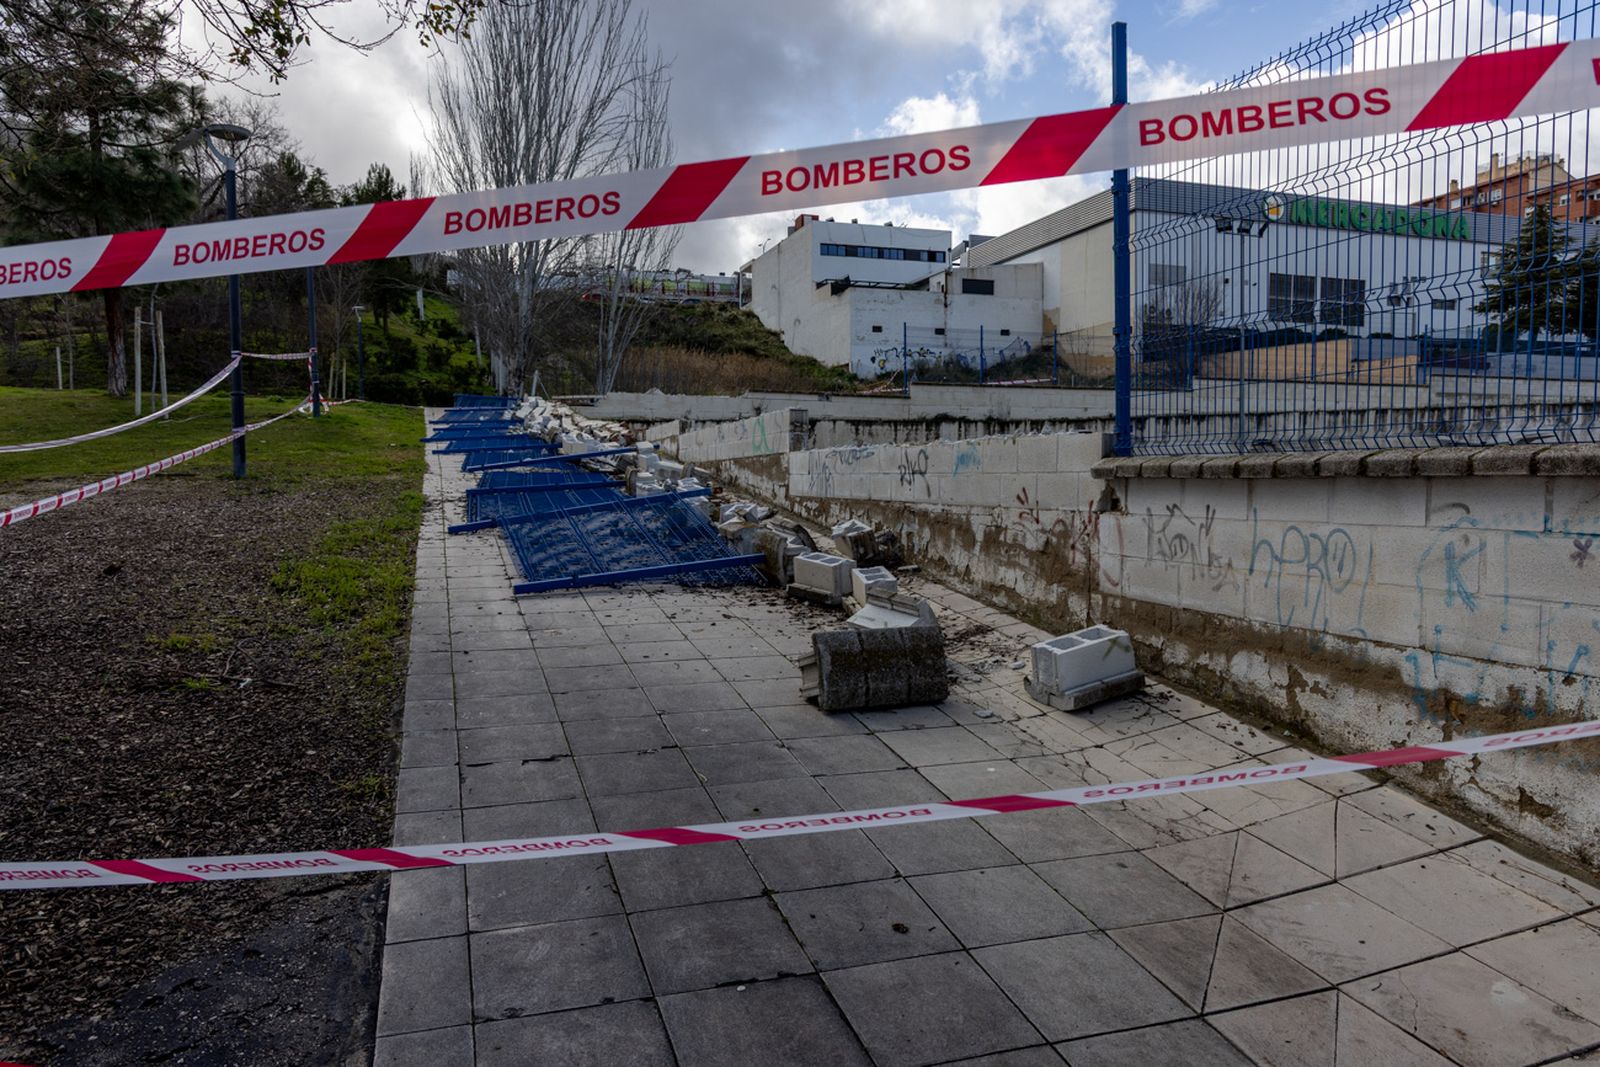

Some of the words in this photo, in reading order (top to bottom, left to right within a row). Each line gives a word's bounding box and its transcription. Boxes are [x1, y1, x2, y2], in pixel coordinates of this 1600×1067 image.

[1139, 87, 1392, 148] BOMBEROS
[761, 144, 971, 196] BOMBEROS
[444, 190, 622, 236] BOMBEROS
[1291, 199, 1470, 240] MERCADONA
[173, 227, 326, 267] BOMBEROS
